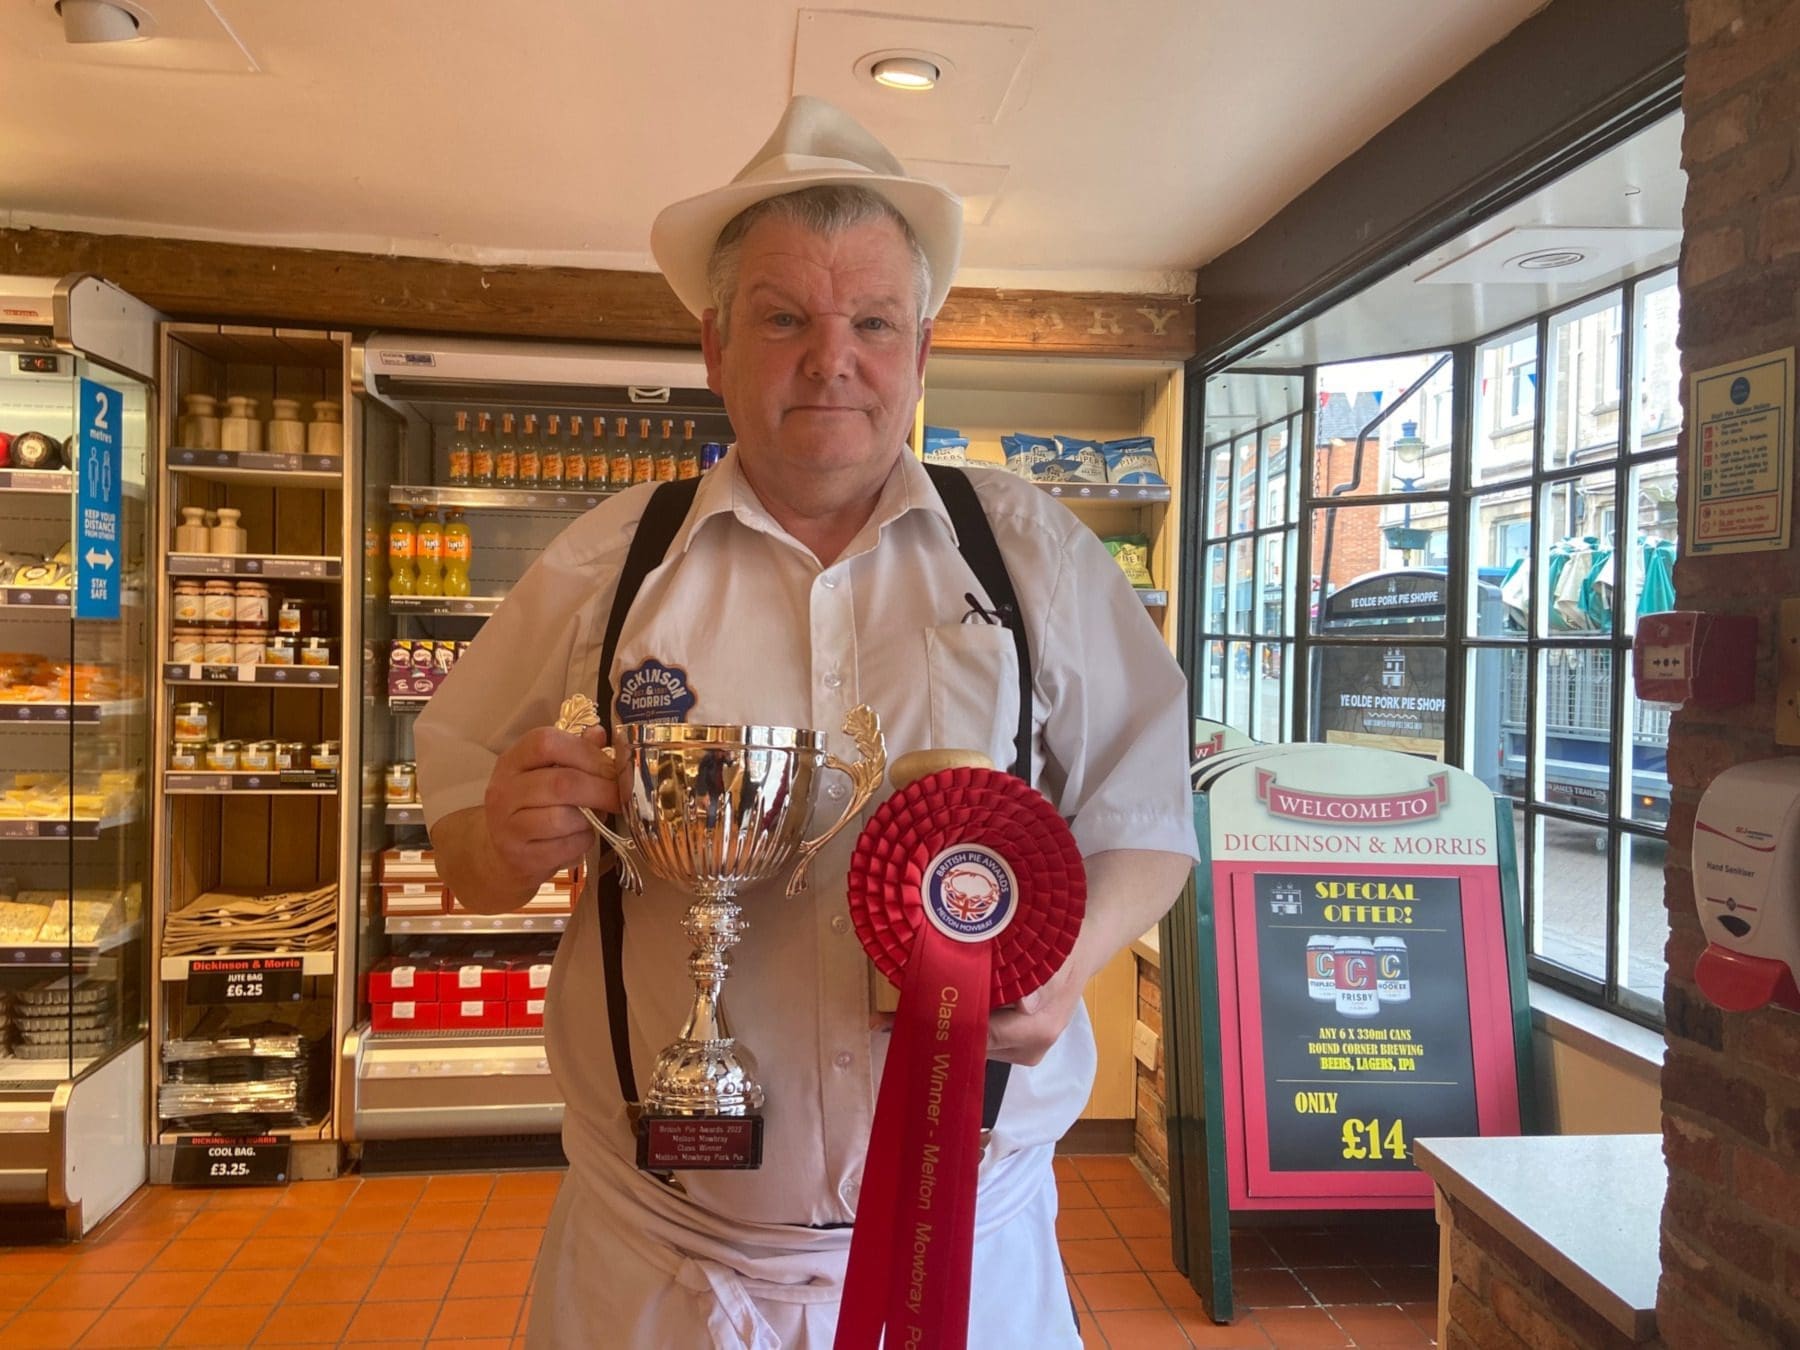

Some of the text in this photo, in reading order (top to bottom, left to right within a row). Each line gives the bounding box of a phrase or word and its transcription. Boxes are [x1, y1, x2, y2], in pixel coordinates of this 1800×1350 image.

[95, 392, 109, 430] 2
[90, 429, 113, 444] metres
[85, 508, 116, 523] KEEP YOUR
[85, 518, 116, 533] DISTANCE
[91, 578, 107, 590] STAY
[90, 587, 107, 600] SAFE
[1359, 596, 1377, 607] OLDE
[1377, 595, 1398, 606] PORK
[1398, 593, 1410, 604] PIE
[1410, 591, 1439, 603] SHOPPE
[620, 668, 687, 705] DICKINSON
[631, 694, 672, 710] MORRIS
[1340, 694, 1350, 707] YE
[1350, 695, 1373, 708] OLDE
[1374, 696, 1400, 709] PORK
[1401, 697, 1416, 710] PIE
[1278, 795, 1428, 819] WELCOME TO
[1223, 833, 1487, 856] DICKINSON & MORRIS
[935, 852, 1009, 893] BRITISH PIE AWARDS
[1706, 861, 1724, 872] Hand
[1315, 881, 1421, 901] SPECIAL
[936, 907, 994, 932] MELTON MOWBRAY
[1324, 905, 1413, 925] OFFER!
[193, 958, 300, 971] Dickinson & Morris
[228, 973, 263, 982] JUTE BAG
[226, 984, 263, 997] £6.25
[1341, 992, 1373, 1002] FRISBY
[936, 985, 959, 1042] Class
[1319, 1028, 1412, 1041] ANY 6 X 330ml CANS
[1308, 1042, 1424, 1056] ROUND CORNER BREWING
[1320, 1057, 1415, 1072] BEERS, LAGERS, IPA
[926, 1053, 950, 1126] Winner
[1295, 1091, 1338, 1114] ONLY
[699, 1126, 724, 1134] Awards
[672, 1135, 728, 1143] Melton Mowbray
[1342, 1118, 1407, 1159] £14
[208, 1147, 233, 1157] COOL
[677, 1144, 696, 1152] Class
[682, 1153, 711, 1162] Mowbray
[918, 1143, 941, 1210] Melton
[905, 1222, 932, 1314] Mowbray
